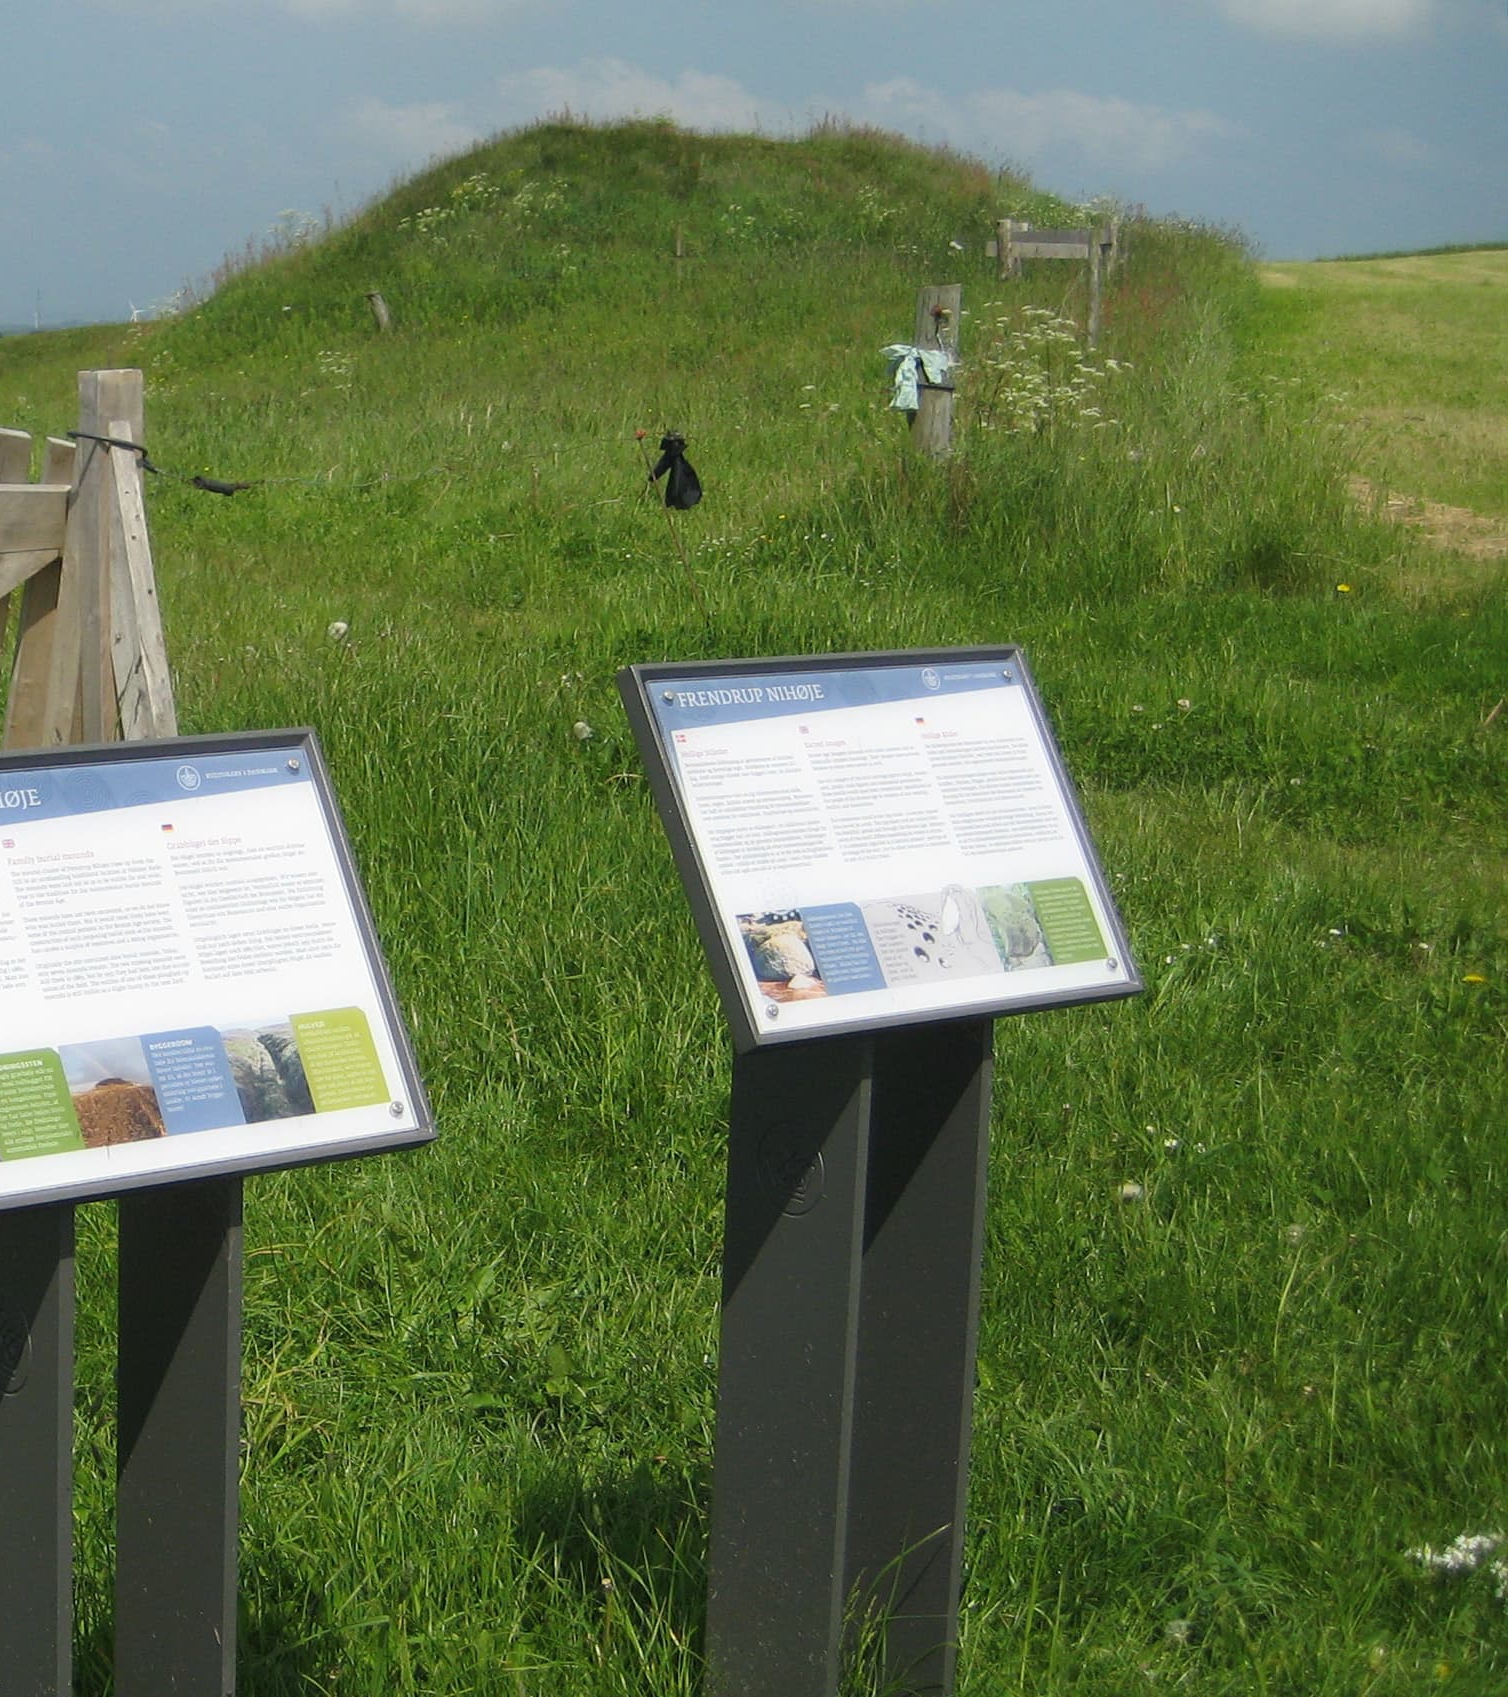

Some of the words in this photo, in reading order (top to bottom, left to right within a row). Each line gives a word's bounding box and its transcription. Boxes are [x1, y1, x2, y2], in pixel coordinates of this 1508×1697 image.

[675, 687, 765, 708] FRENDRUP
[764, 684, 825, 703] NIHØJE
[6, 856, 35, 867] Family
